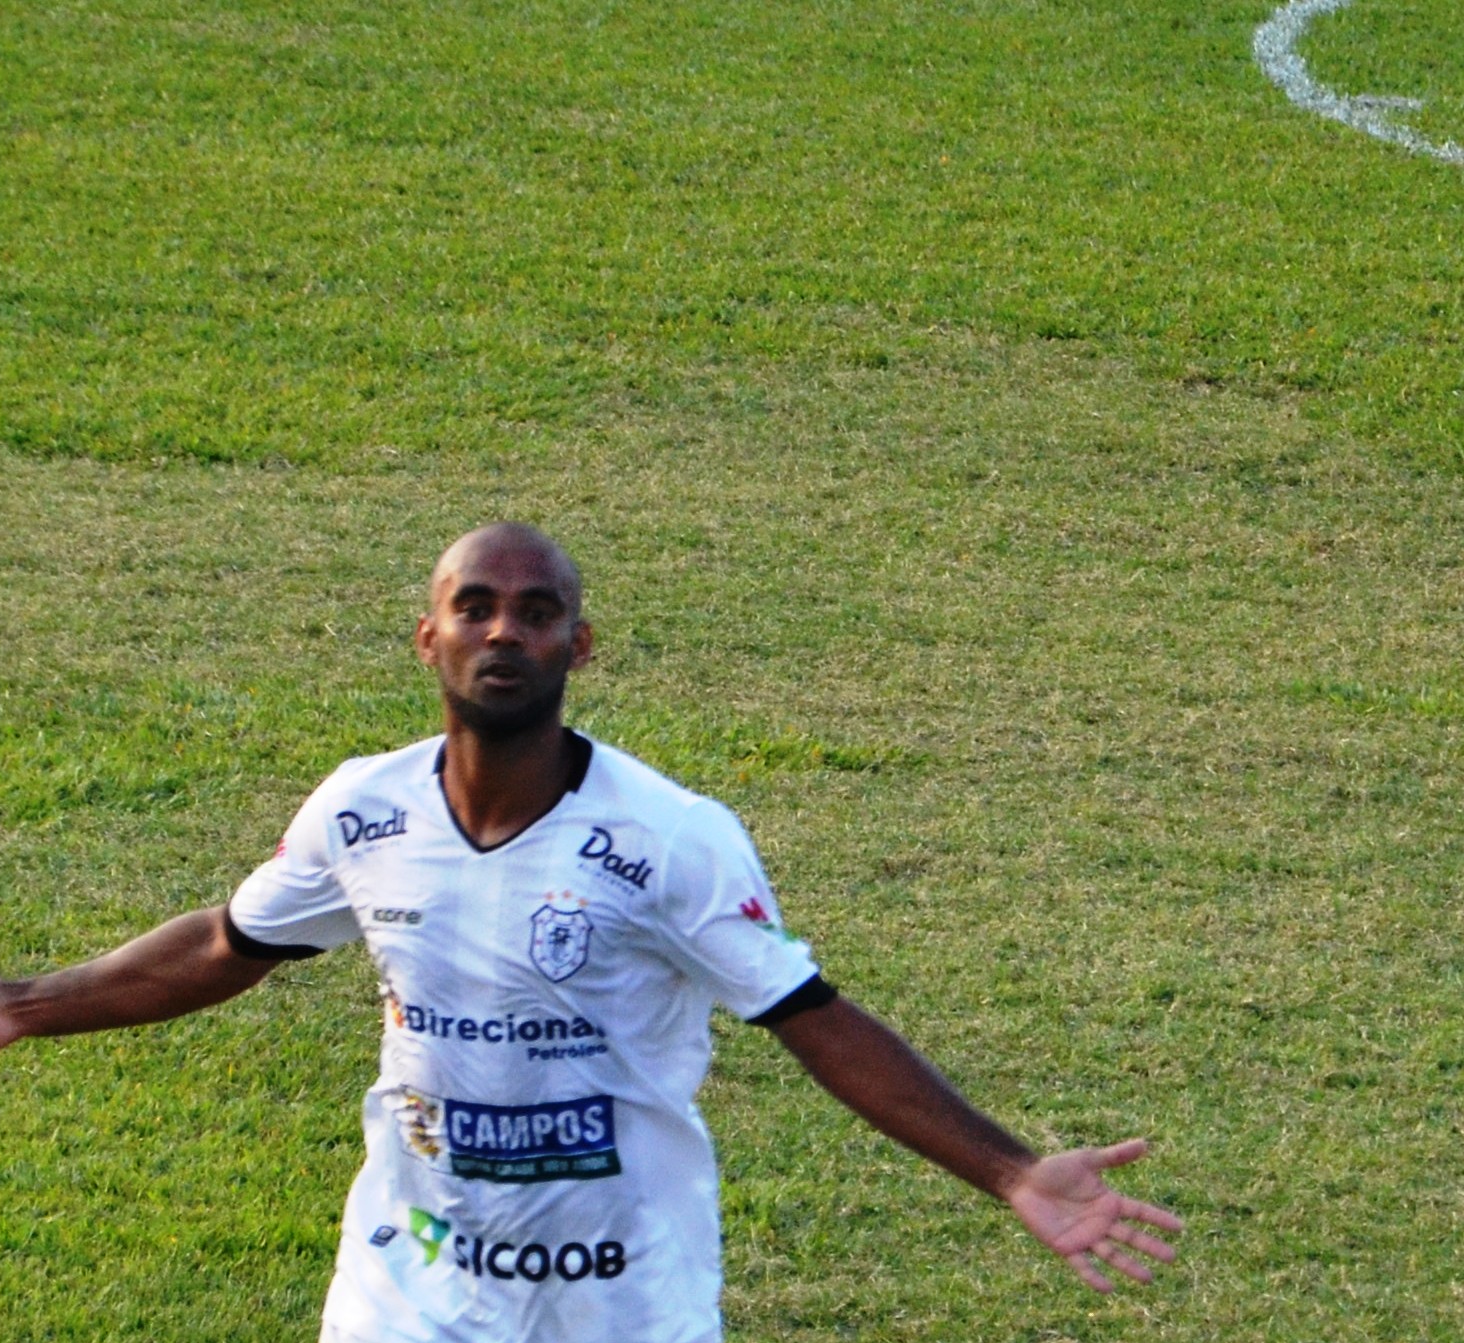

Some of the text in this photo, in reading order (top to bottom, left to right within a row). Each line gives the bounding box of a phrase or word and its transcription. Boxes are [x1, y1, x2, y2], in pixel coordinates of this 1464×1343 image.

[336, 808, 408, 848] Dadi
[579, 826, 653, 890] Dadi
[450, 1105, 606, 1150] CAMPOS
[454, 1235, 627, 1283] SICOOB
